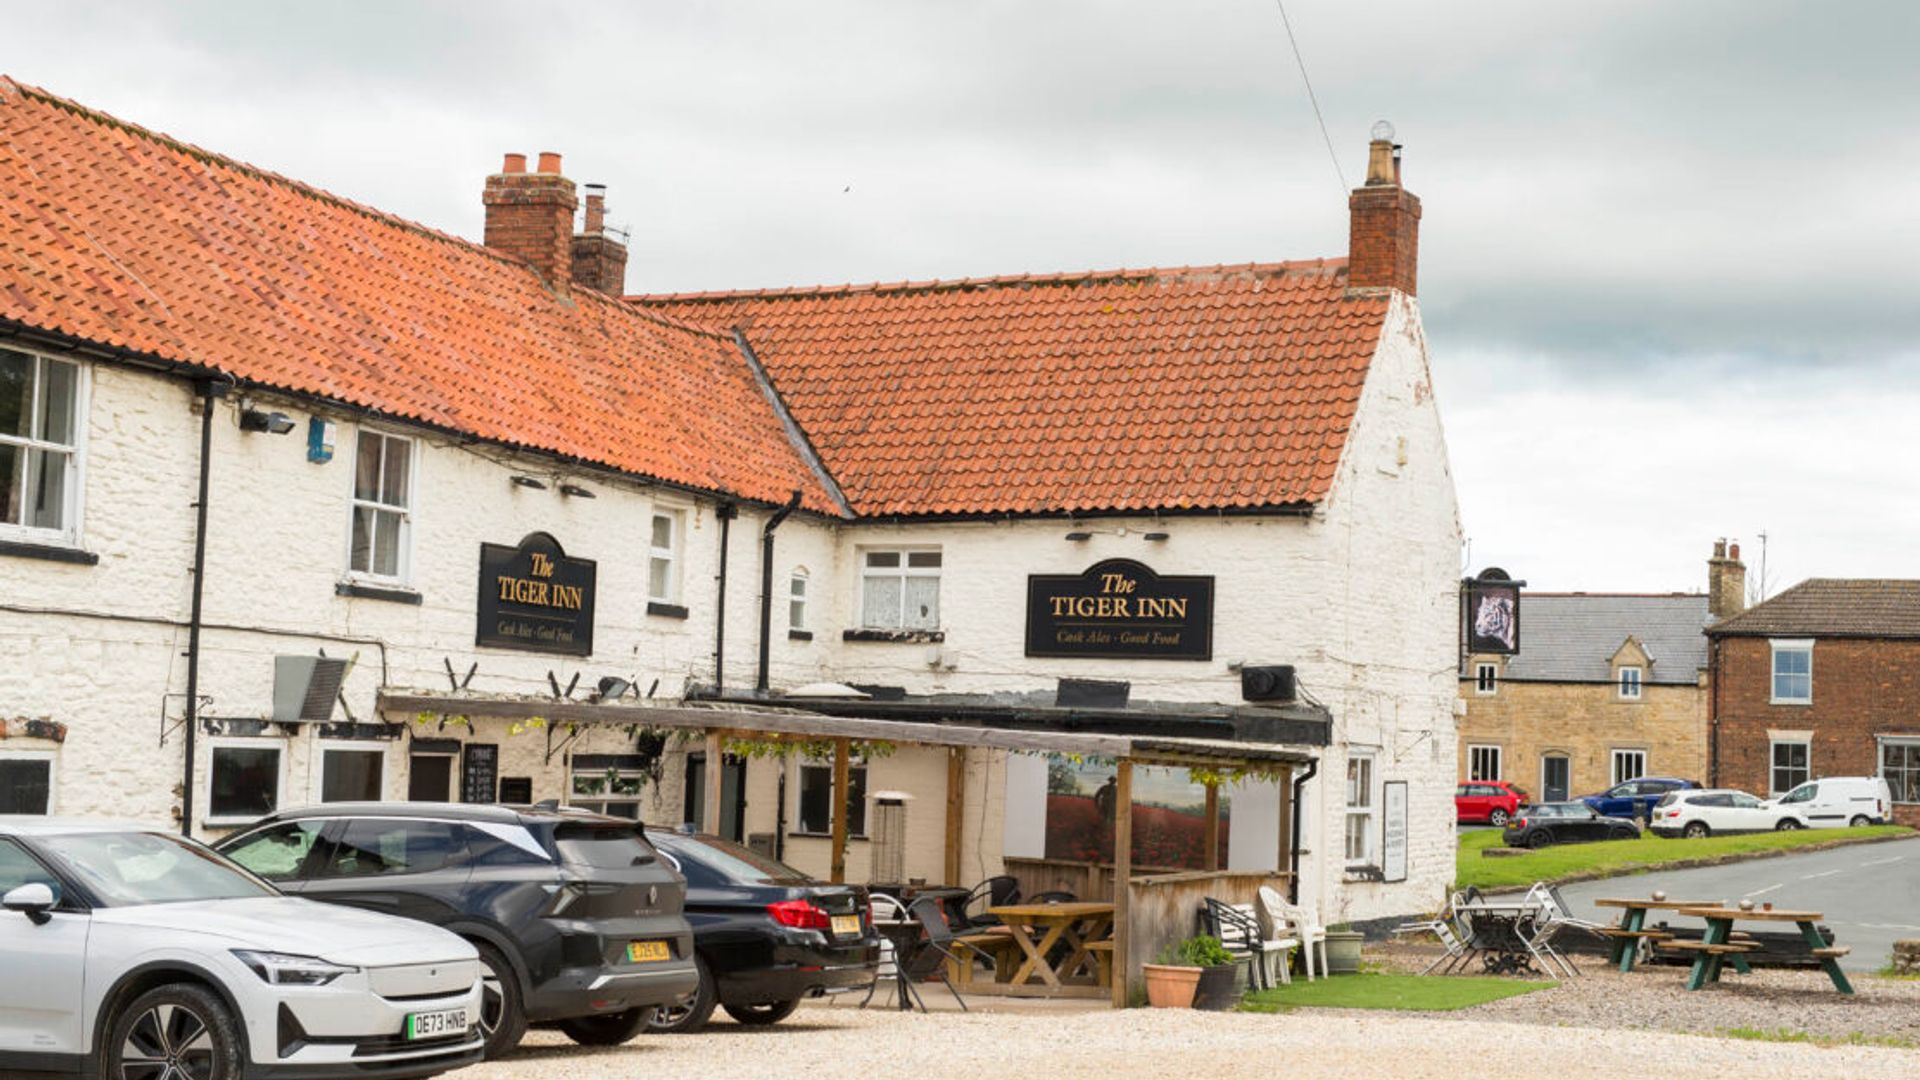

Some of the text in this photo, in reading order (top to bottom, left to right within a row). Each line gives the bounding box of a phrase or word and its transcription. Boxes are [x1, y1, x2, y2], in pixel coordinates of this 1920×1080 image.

[531, 552, 554, 578] The
[498, 576, 583, 610] TIGER INN
[1101, 573, 1137, 593] The
[1050, 596, 1188, 619] TIGER INN
[1056, 629, 1180, 646] Cask Ales Good Food
